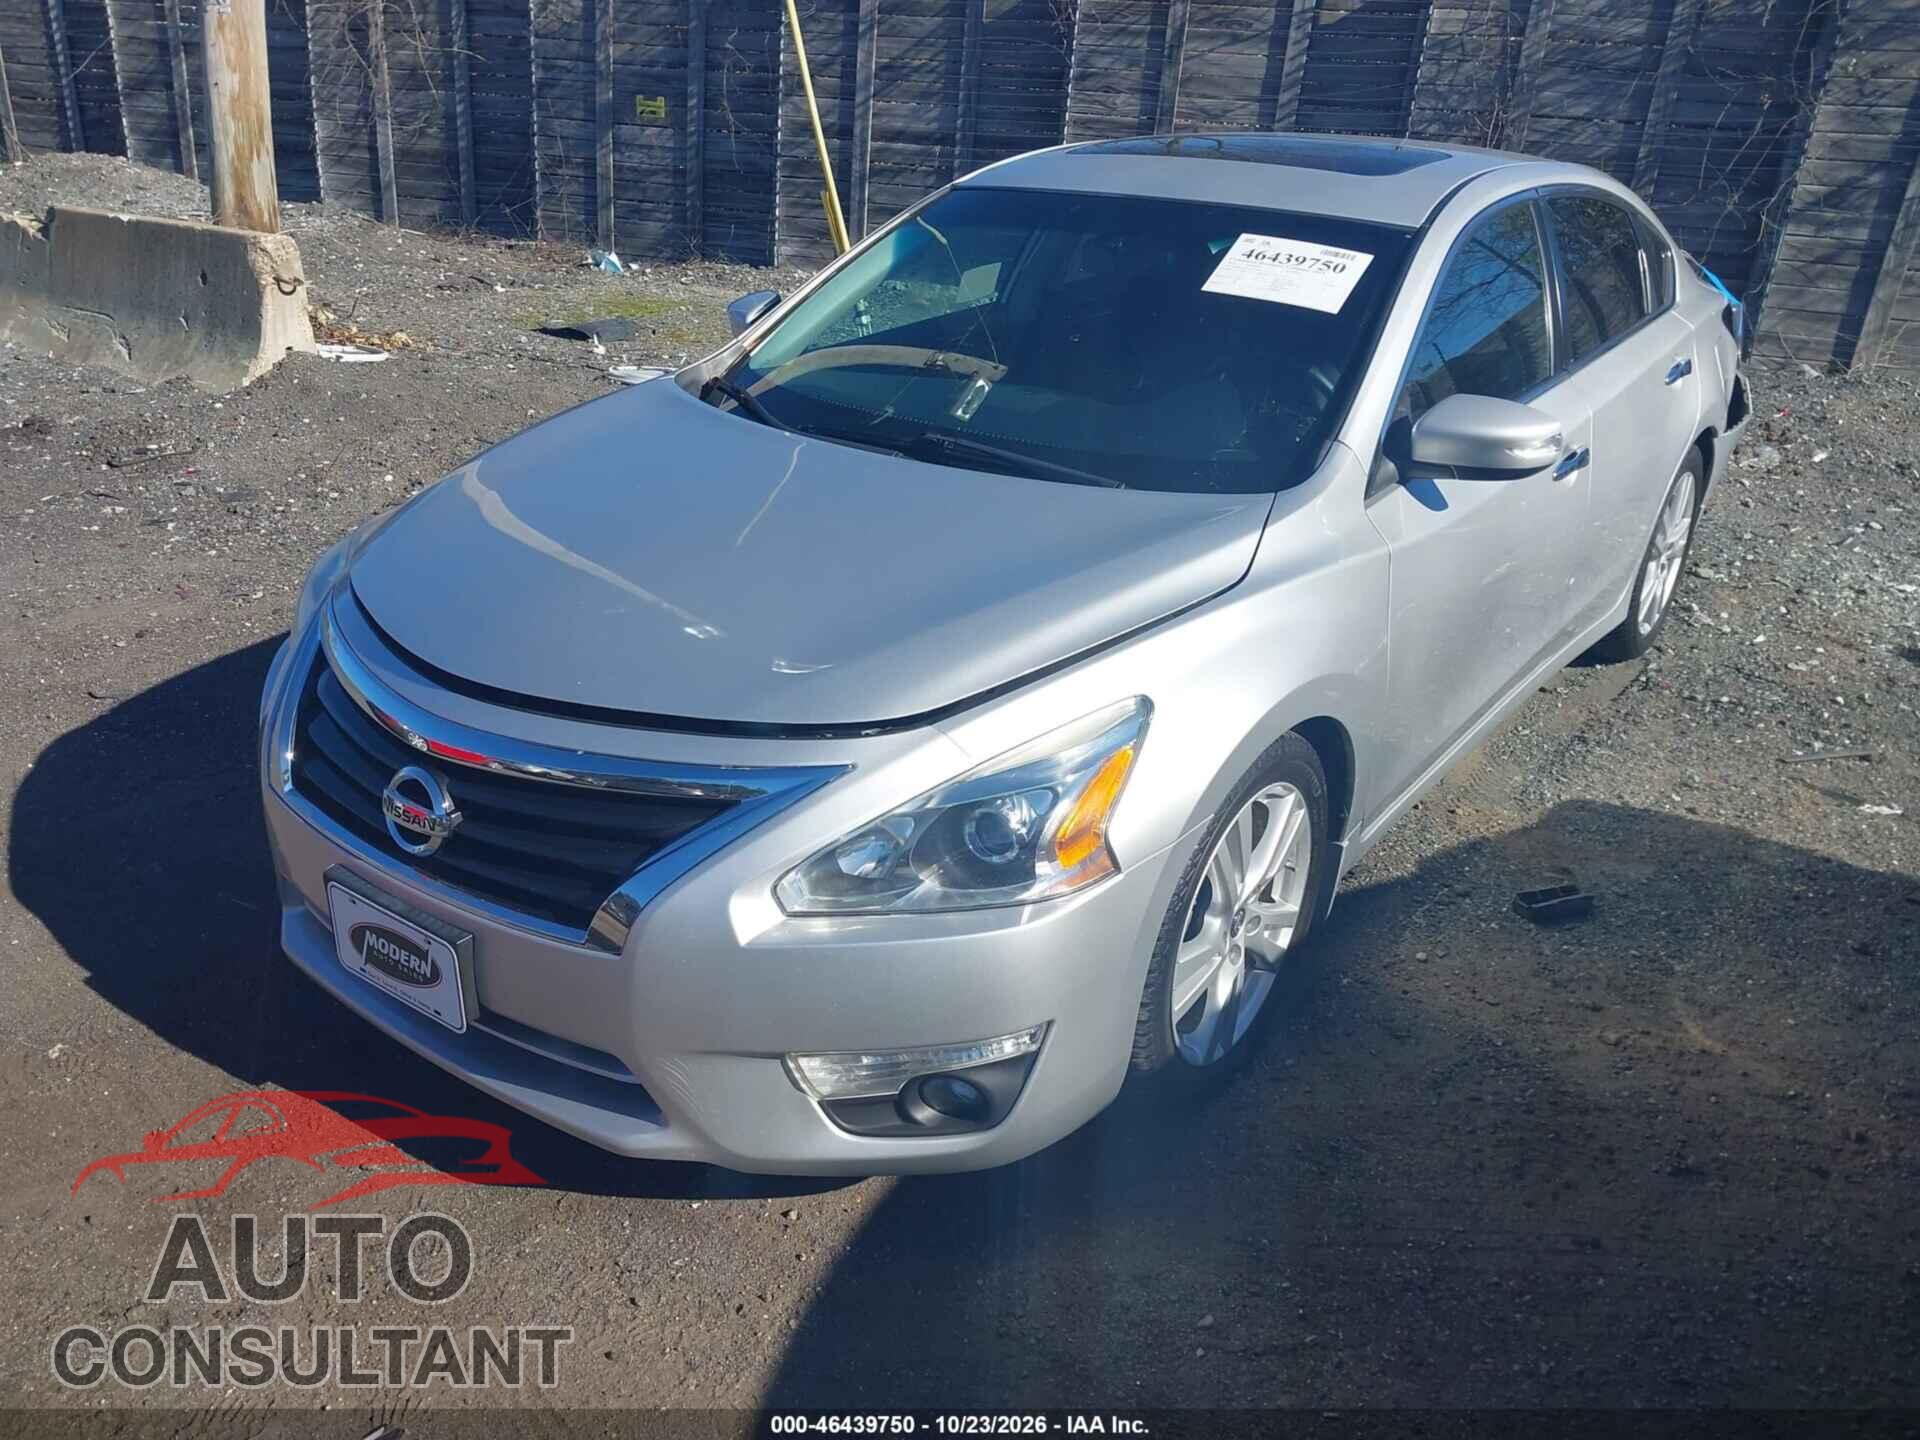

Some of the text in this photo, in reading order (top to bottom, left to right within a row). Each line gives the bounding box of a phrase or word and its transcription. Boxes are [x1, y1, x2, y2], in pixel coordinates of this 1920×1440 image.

[1241, 248, 1347, 274] 46439750
[383, 794, 437, 832] NISSAN
[362, 929, 433, 978] MODERN
